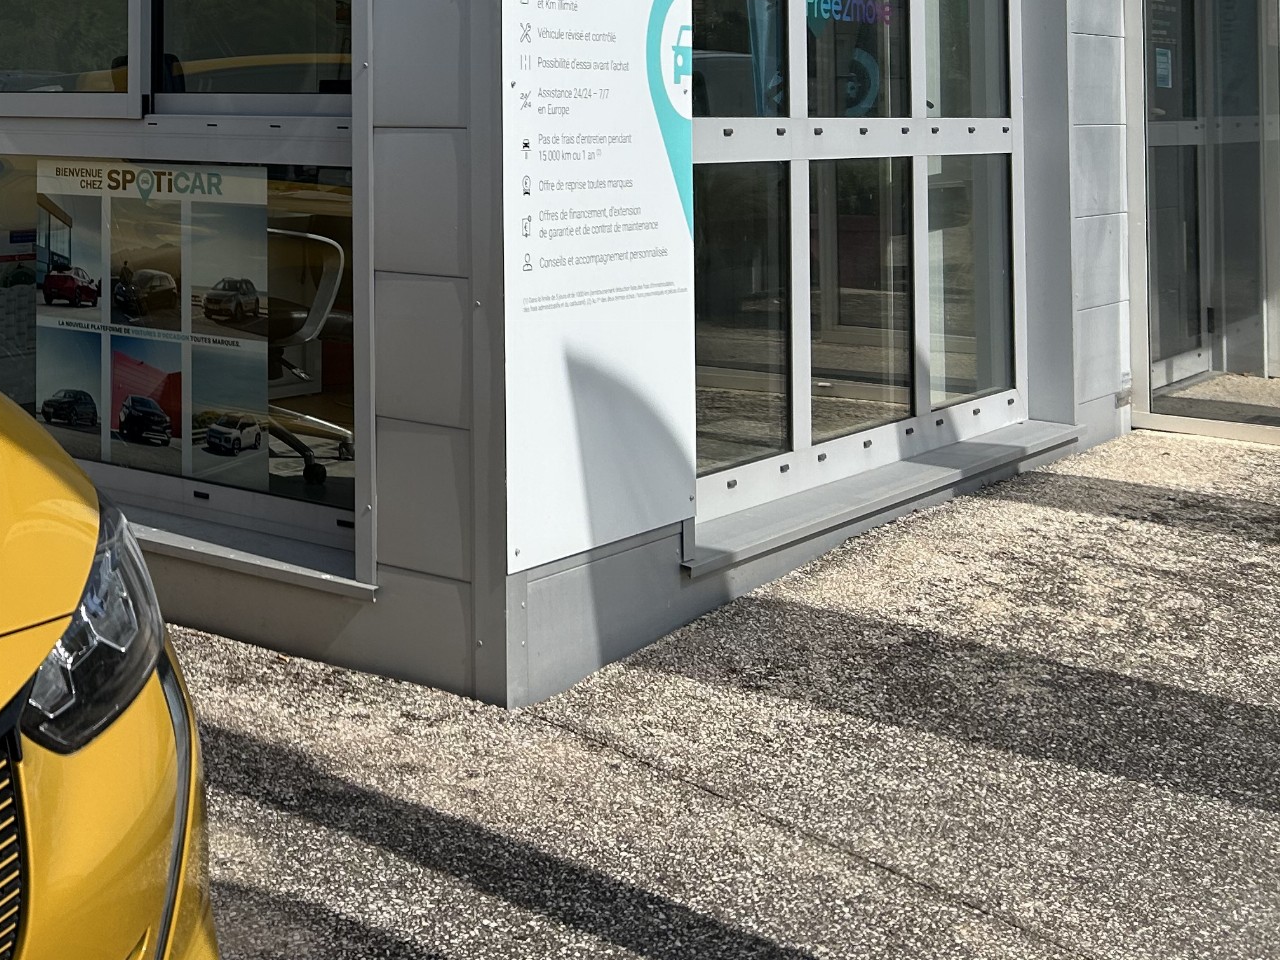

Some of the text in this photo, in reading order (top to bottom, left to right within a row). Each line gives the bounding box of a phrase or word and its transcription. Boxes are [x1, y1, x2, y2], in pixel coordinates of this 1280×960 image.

[538, 0, 544, 9] et
[538, 28, 616, 43] Véhicule révisé et contrôlé
[538, 56, 630, 72] Possibilité d'essai avant l'achat
[538, 88, 572, 99] Assistance
[538, 104, 570, 117] en Europe
[538, 133, 632, 146] Pas de frais d'entretien pendant
[539, 150, 547, 161] 15
[548, 150, 560, 161] 000
[562, 150, 571, 160] km
[572, 152, 580, 160] ou
[588, 152, 595, 160] an
[55, 166, 103, 178] BIENVENUE
[80, 179, 103, 189] CHEZ
[539, 179, 633, 192] Offre de reprise toutes marques
[539, 210, 558, 222] Offres
[560, 209, 568, 220] de
[539, 220, 658, 240] de garantie et de contrat de maintenance
[540, 256, 566, 268] Conseils
[568, 255, 574, 266] et
[575, 250, 629, 266] accompagnement
